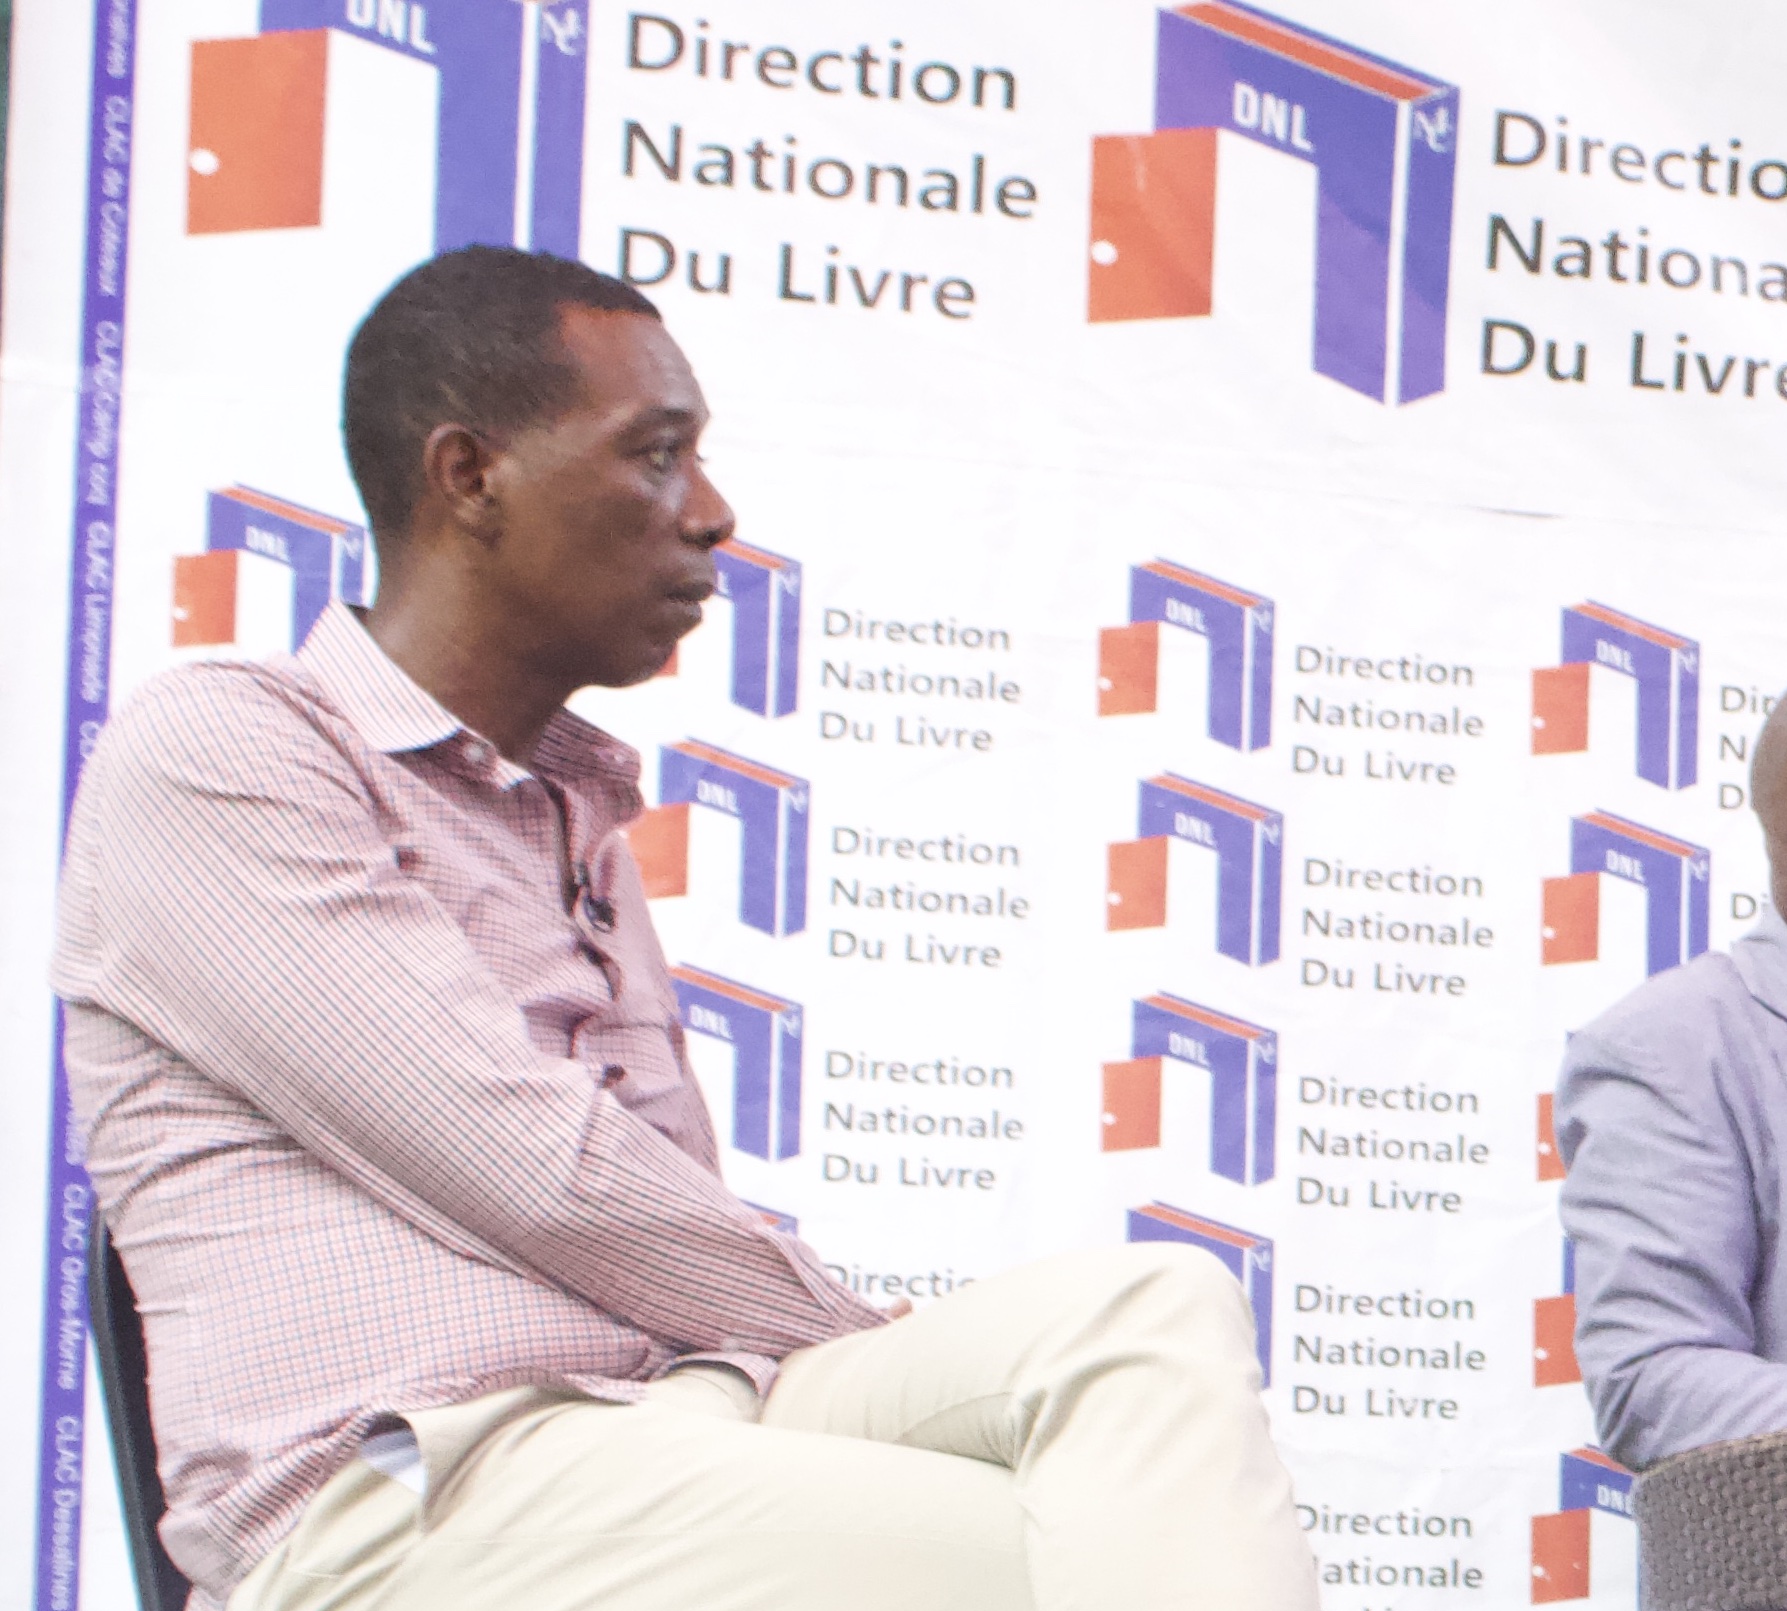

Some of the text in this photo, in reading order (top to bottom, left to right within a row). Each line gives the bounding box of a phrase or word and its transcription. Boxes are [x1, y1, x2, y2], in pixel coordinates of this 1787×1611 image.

[626, 11, 1017, 112] Direction
[1232, 80, 1315, 154] DNL
[622, 119, 1039, 220] Nationale
[617, 226, 977, 320] Du Livre
[1480, 318, 1588, 384] Du
[822, 607, 1011, 652] Direction
[820, 659, 1022, 704] Nationale
[1294, 644, 1475, 687] Direction
[819, 710, 994, 753] Du Livre
[1293, 694, 1485, 738] Nationale
[1291, 744, 1457, 786] Du Livre
[831, 825, 1021, 867] Direction
[829, 877, 1030, 920] Nationale
[1302, 857, 1484, 898] Direction
[828, 928, 1003, 969] Du Livre
[1302, 907, 1495, 949] Nationale
[1300, 957, 1467, 997] Du Livre
[1294, 1283, 1475, 1320] Direction
[1293, 1334, 1487, 1372] Nationale
[1292, 1384, 1459, 1421] Du Livre
[1294, 1504, 1473, 1538] Direction
[1312, 1555, 1484, 1589] ationale
